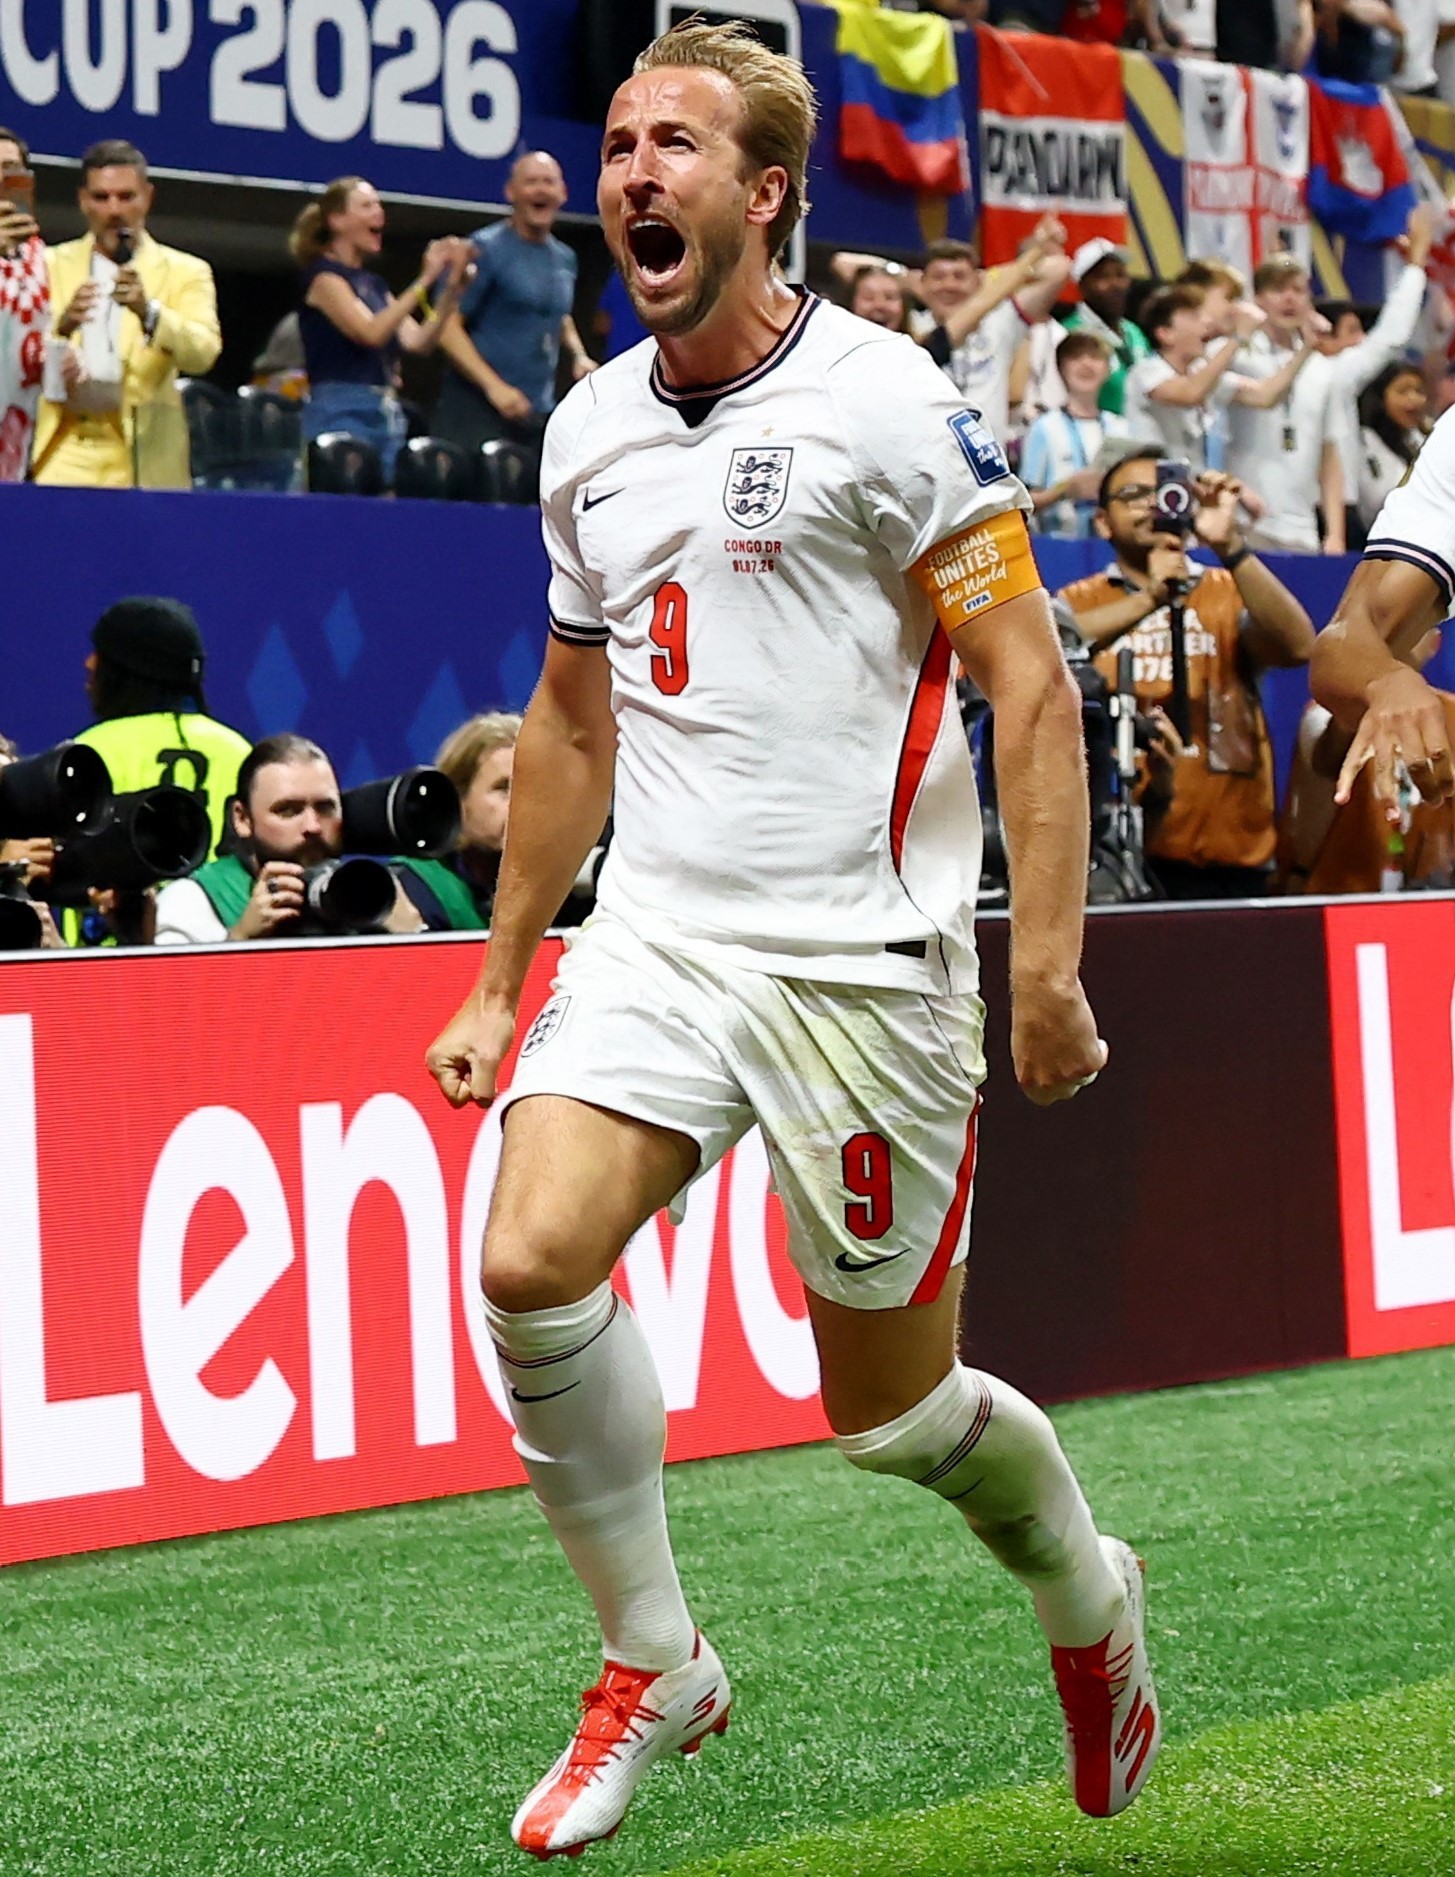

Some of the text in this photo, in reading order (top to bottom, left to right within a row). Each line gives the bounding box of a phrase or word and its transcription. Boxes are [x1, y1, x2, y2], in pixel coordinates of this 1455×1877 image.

[0, 0, 521, 159] CUP 2026
[724, 539, 782, 554] CONGO DR
[929, 528, 995, 571] FOOTBALL
[933, 541, 1001, 590] UNITES
[941, 560, 1008, 609] the World
[965, 593, 991, 612] FIFA
[649, 581, 690, 697] 9
[841, 1131, 893, 1241] 9
